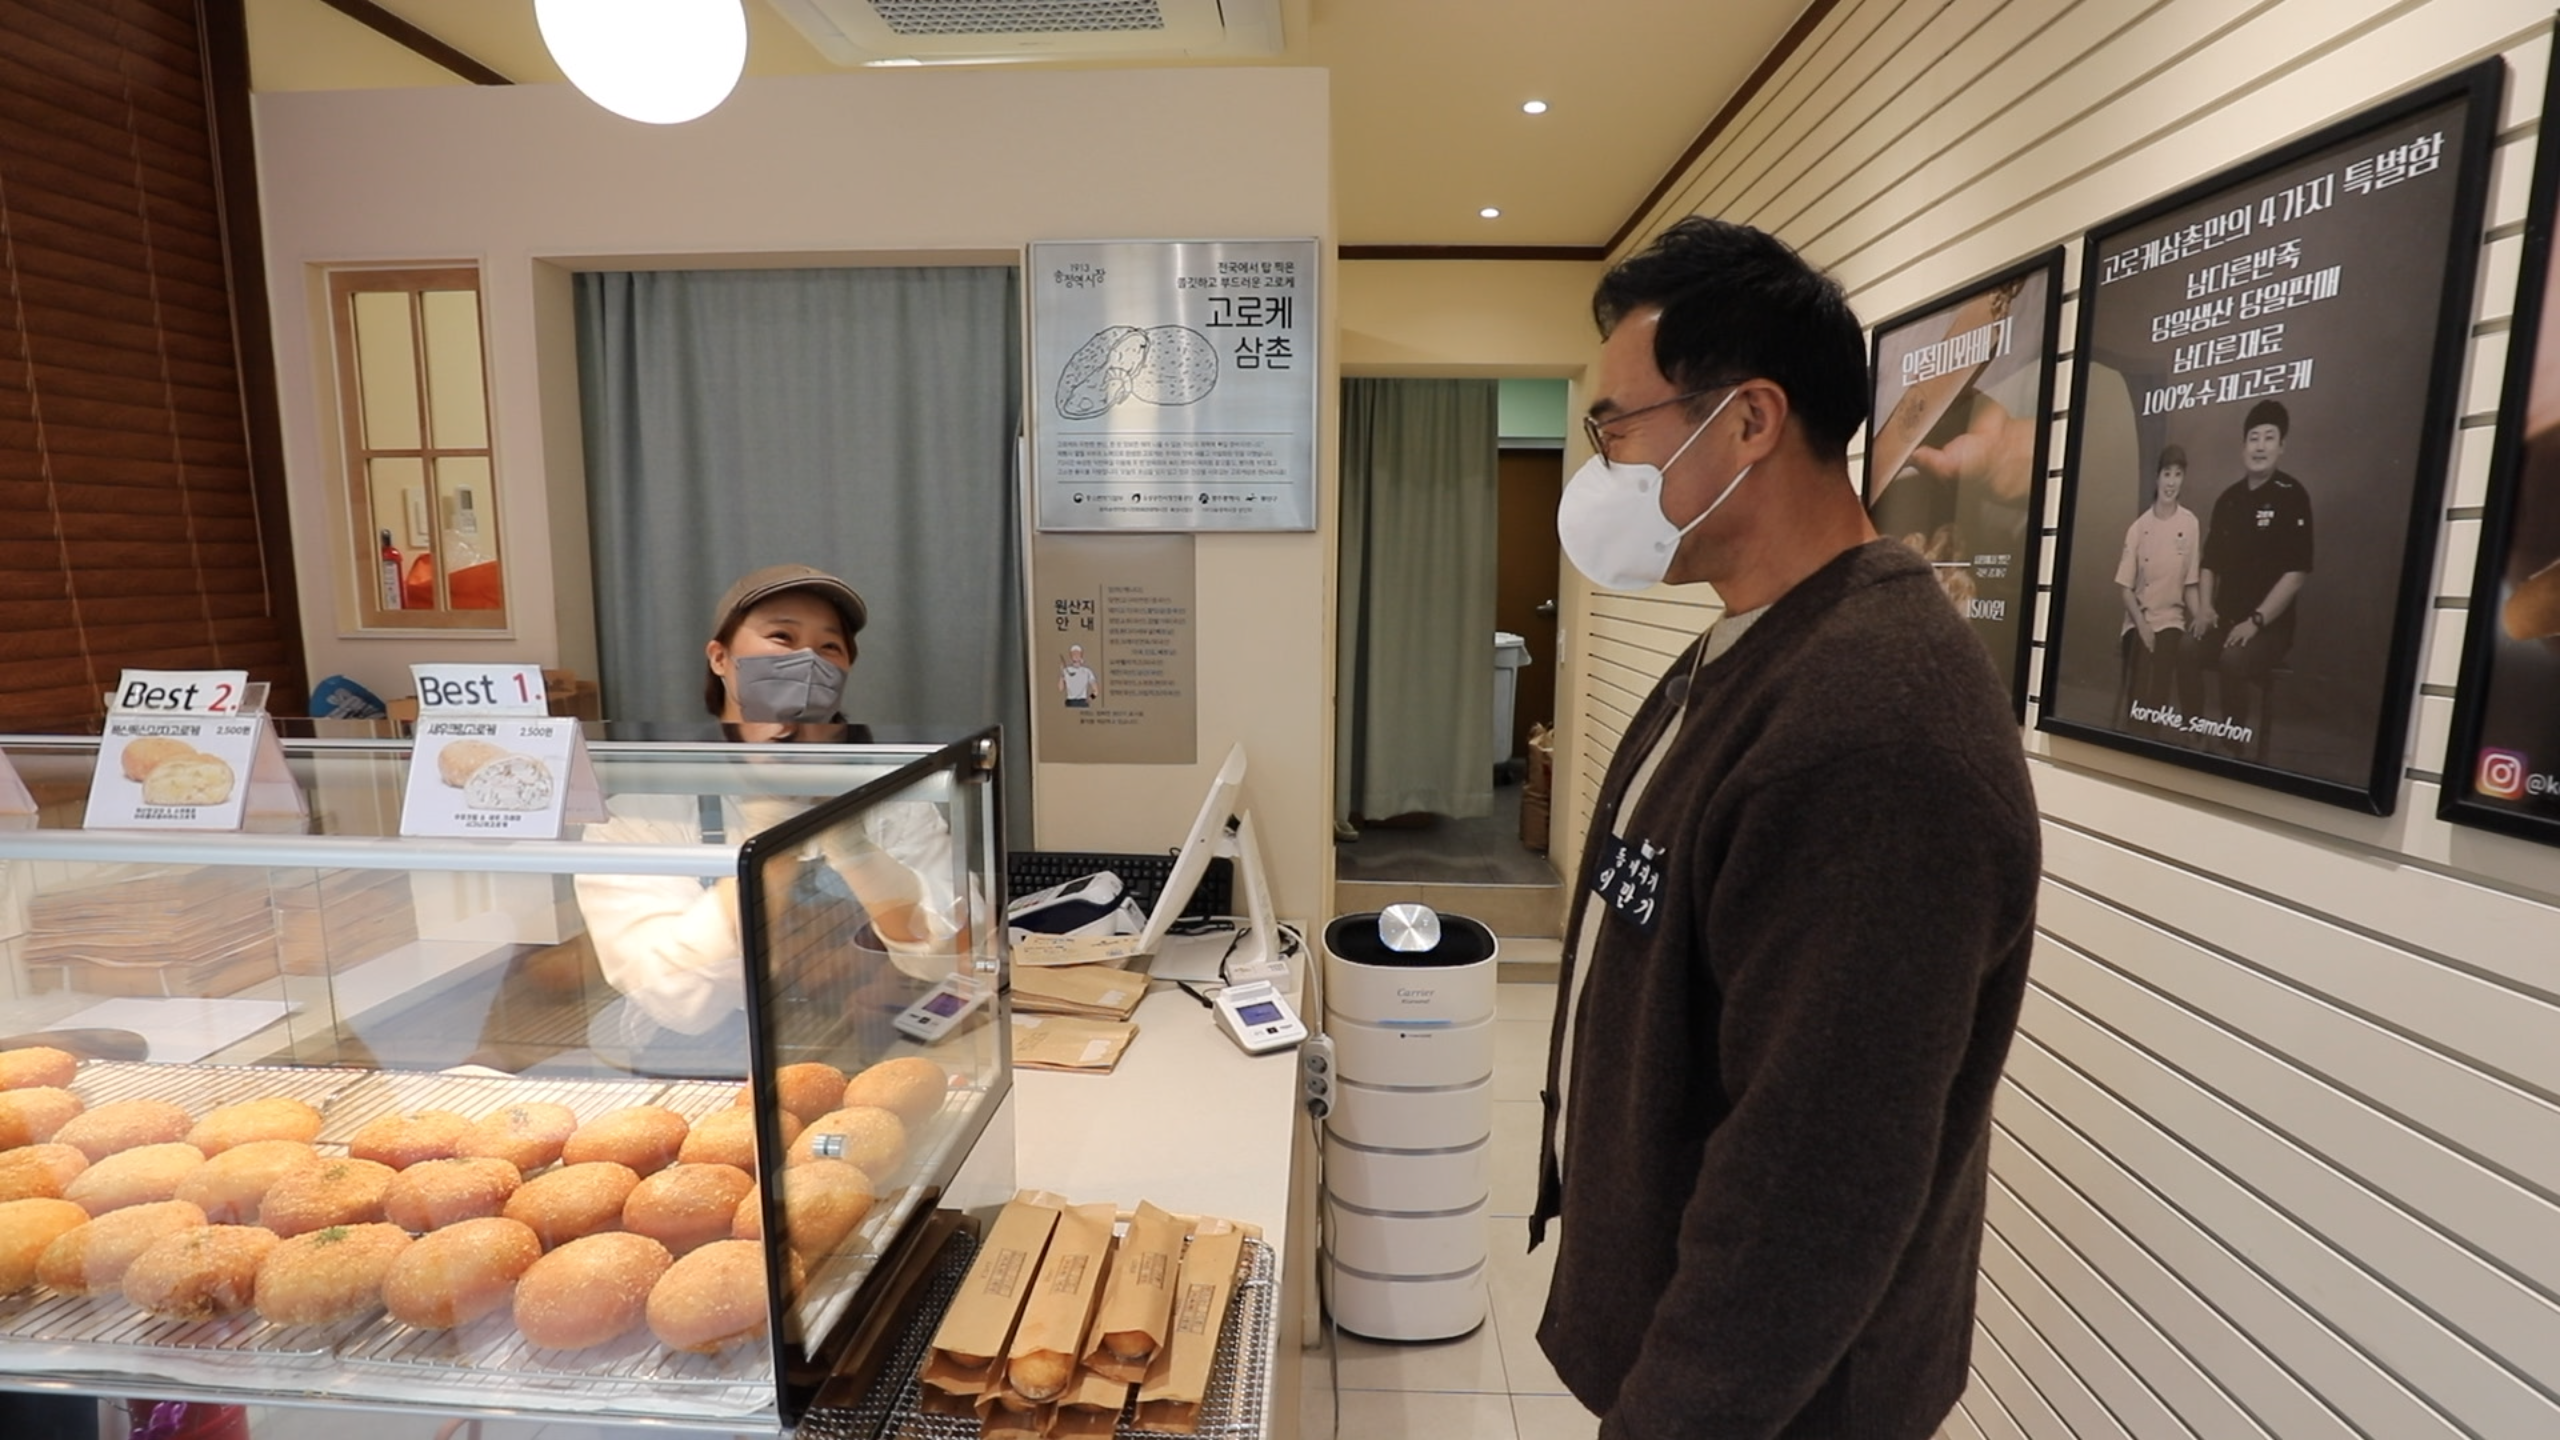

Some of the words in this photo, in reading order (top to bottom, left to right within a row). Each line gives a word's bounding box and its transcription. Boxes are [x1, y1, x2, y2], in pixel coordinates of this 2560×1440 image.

[2101, 205, 2252, 285] 고로케삼촌만의
[2344, 132, 2444, 196] 특별함
[1054, 268, 1106, 288] 송정역시장
[1070, 263, 1090, 272] 1913
[1218, 262, 1258, 273] 전국에서
[1260, 262, 1272, 273] 탑
[1221, 277, 1261, 288] 부드러운
[1264, 277, 1295, 288] 고로케
[2186, 240, 2302, 298] 남다른반죽
[1206, 296, 1293, 329] 고로케
[2151, 295, 2234, 342] 당일생산
[2239, 265, 2342, 320] 당일판매
[1235, 337, 1293, 369] 삼촌
[1902, 316, 2013, 386] 인절미꽈배기
[2173, 324, 2285, 374] 남다른재료
[2142, 358, 2314, 416] 100%수제고로케
[1054, 599, 1095, 615] 원산지
[122, 681, 199, 711] Best
[208, 683, 236, 712] 2.
[419, 674, 497, 706] Best
[513, 672, 541, 704] 1.
[216, 725, 251, 736] 2,500원
[520, 727, 553, 737] 2,500원
[2129, 699, 2253, 744] korokke_samchon
[2525, 772, 2560, 796] @k
[1599, 868, 1655, 924] 이만기
[1397, 987, 1435, 997] Carrier
